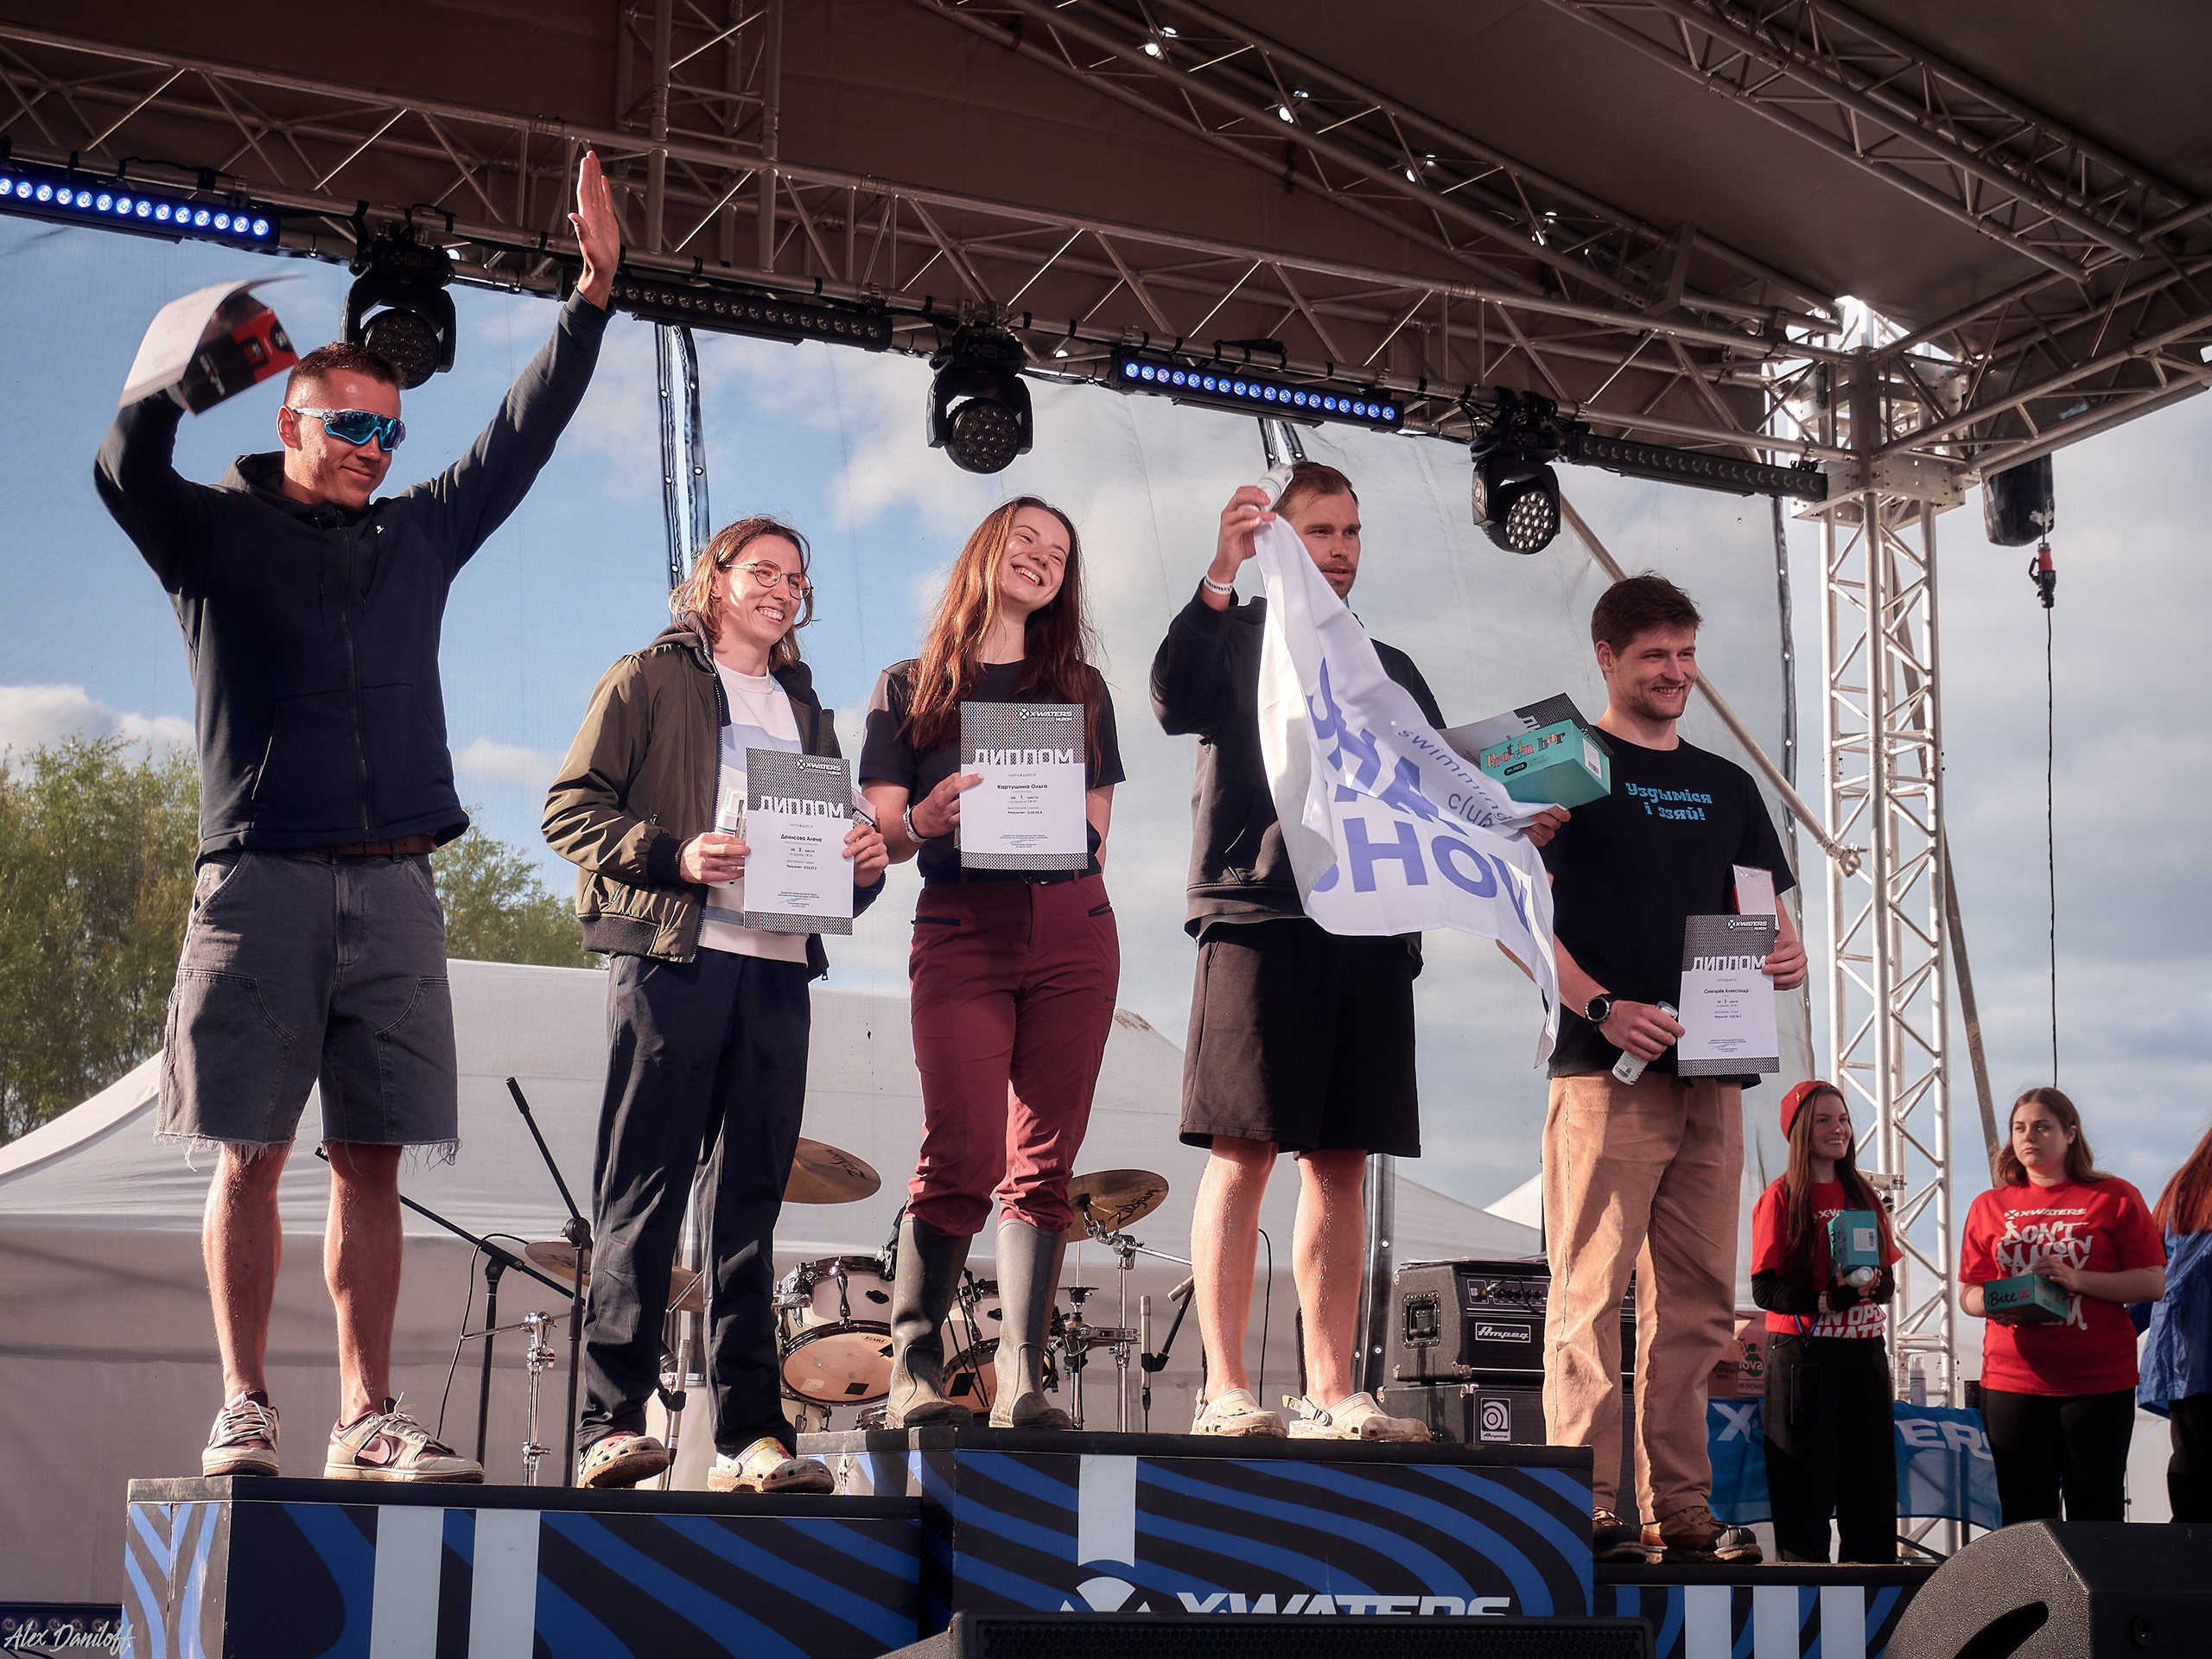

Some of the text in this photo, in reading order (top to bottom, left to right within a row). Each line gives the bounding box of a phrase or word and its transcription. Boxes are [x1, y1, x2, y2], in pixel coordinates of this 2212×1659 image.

[974, 748, 1074, 766] ДИПЛОМ
[1485, 740, 1534, 769] Protein
[1537, 732, 1566, 753] bar
[1398, 730, 1514, 822] swimming
[760, 796, 844, 819] ДИПЛОМ
[1448, 793, 1493, 829] club
[1657, 806, 1707, 821] ззяй!
[1693, 955, 1766, 971] ДИПЛОМ
[1989, 1291, 2018, 1306] Bite
[1478, 1326, 1529, 1339] Ampeg
